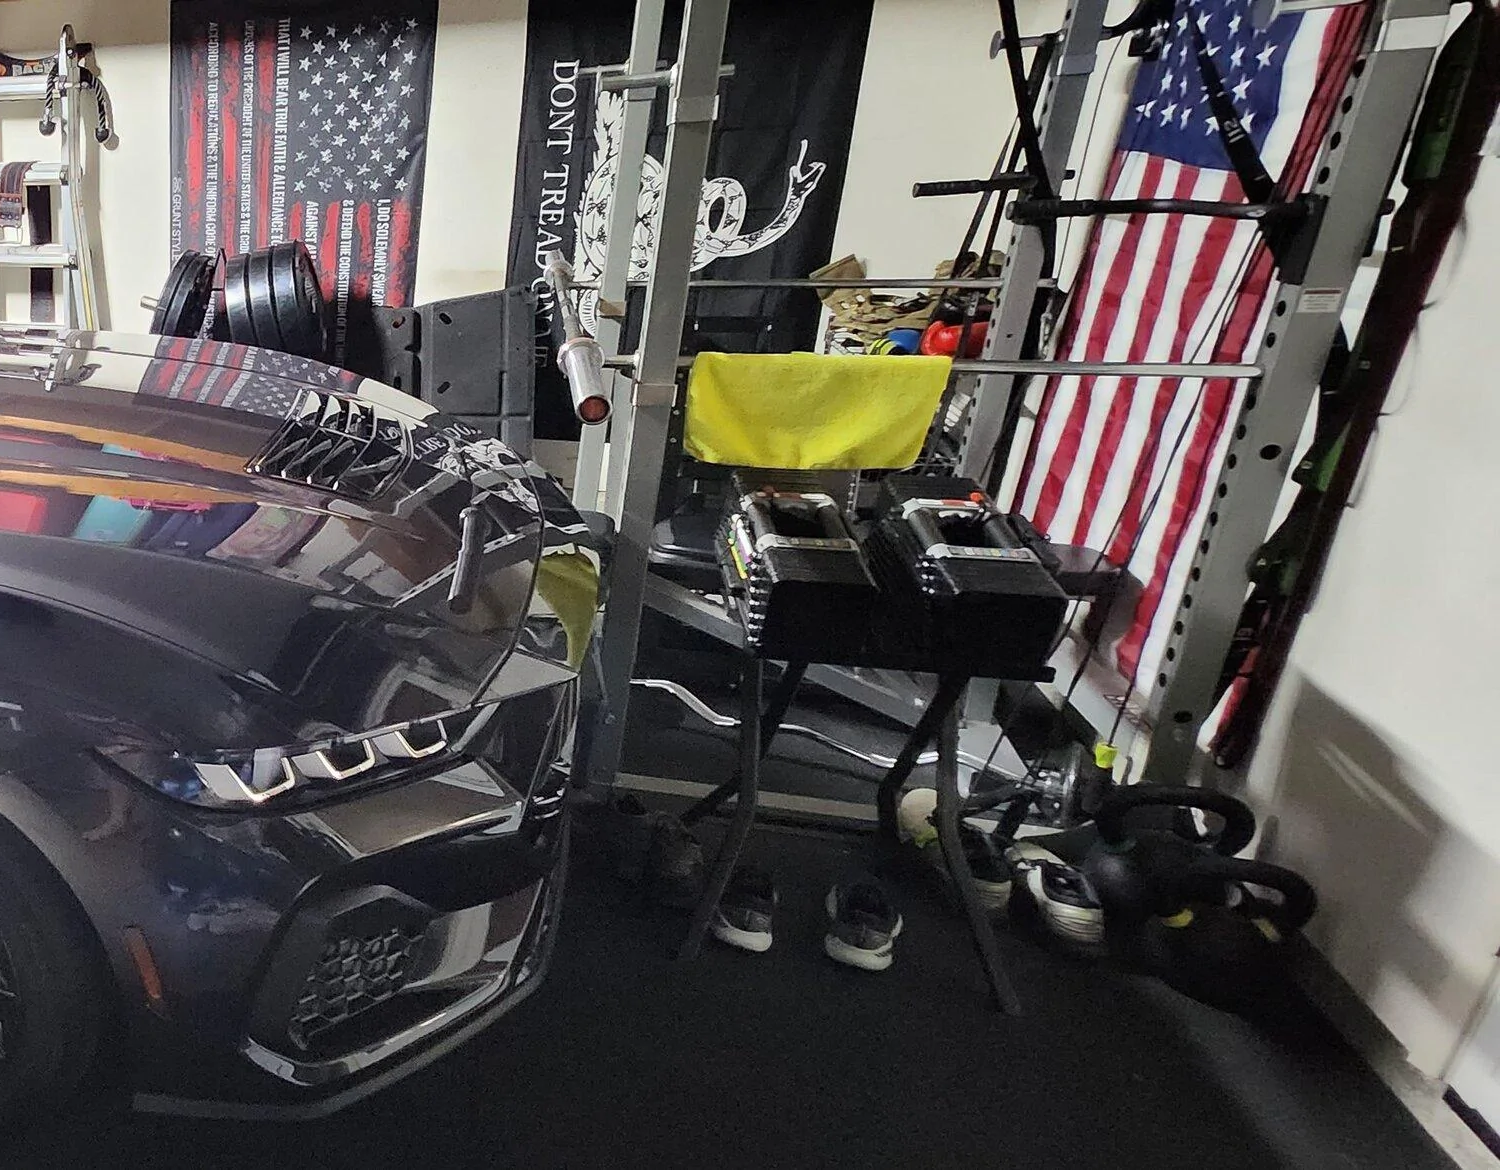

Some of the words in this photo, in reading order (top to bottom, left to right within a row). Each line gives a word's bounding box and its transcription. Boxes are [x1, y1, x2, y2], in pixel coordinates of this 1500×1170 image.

[278, 18, 291, 45] THAT
[207, 22, 219, 78] ACCORDING
[242, 55, 254, 66] OF
[276, 52, 290, 77] WILL
[207, 79, 218, 92] TO
[275, 78, 289, 106] BEAR
[275, 107, 289, 134] TRUE
[547, 59, 579, 155] DONT
[206, 155, 218, 163] &
[273, 135, 287, 163] FAITH
[206, 163, 218, 181] THE
[273, 165, 285, 174] &
[172, 194, 182, 229] GRUNT
[205, 181, 217, 223] UNIFORM
[240, 184, 251, 212] STATES
[271, 174, 286, 233] ALLEGIANCE
[240, 220, 250, 234] THE
[306, 201, 319, 243] AGAINST
[341, 208, 354, 239] DEFEND
[377, 207, 390, 222] DO
[205, 223, 216, 246] CODE
[340, 240, 352, 256] THE
[374, 222, 389, 274] SOLEMNLY
[372, 274, 387, 307] SWEAR
